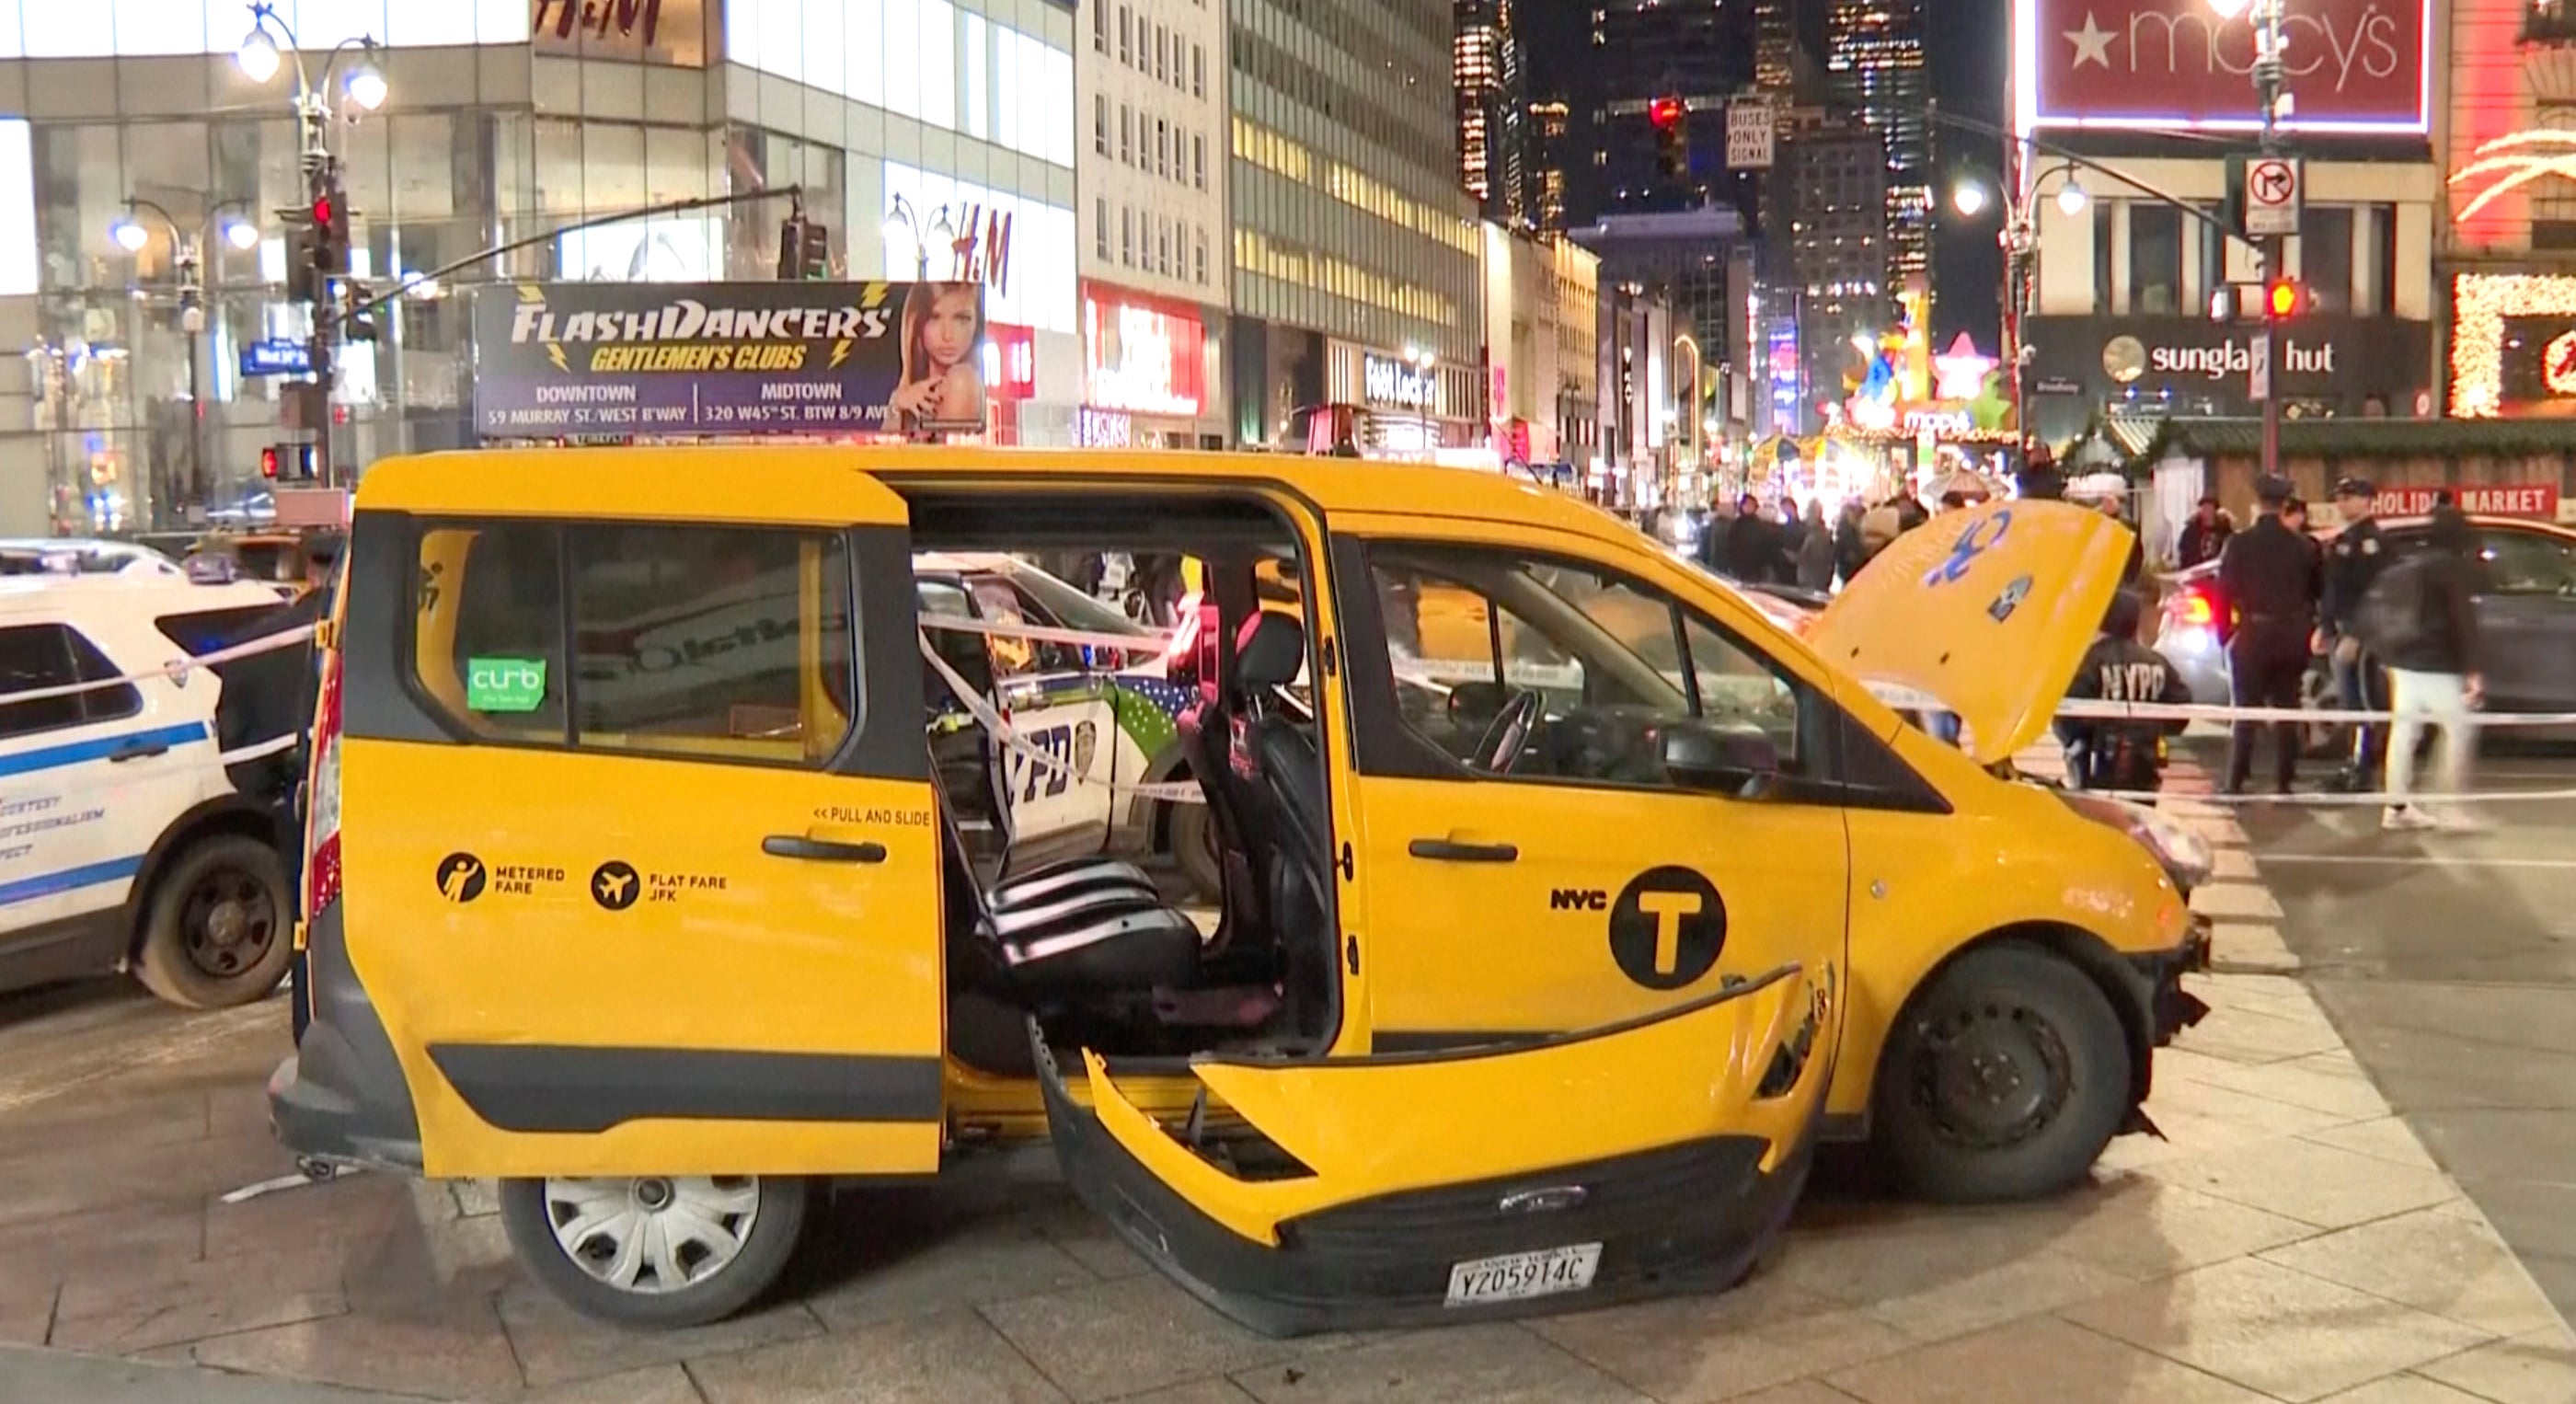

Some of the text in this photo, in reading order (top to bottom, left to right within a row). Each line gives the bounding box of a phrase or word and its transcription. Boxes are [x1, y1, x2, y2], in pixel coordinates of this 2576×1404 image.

[1731, 111, 1770, 127] BUSES
[1733, 130, 1766, 144] ONLY
[1731, 148, 1768, 162] SIGNAL
[590, 344, 808, 373] GENTLEMEN'S CLUBS
[2152, 339, 2334, 379] sungla hut
[536, 385, 637, 403] DOWNTOWN
[761, 382, 843, 400] MIDTOWN
[489, 409, 506, 425] 59
[510, 409, 570, 424] MURRAY
[641, 406, 686, 421] B'WAY
[705, 405, 733, 420] 320
[804, 405, 836, 420] BTW
[838, 405, 863, 420] 8/9
[2367, 489, 2546, 516] HOLID MARKET
[472, 668, 540, 689] curb
[2099, 662, 2166, 702] NYPD
[831, 807, 862, 823] PULL
[865, 809, 892, 824] AND
[895, 810, 930, 827] SLIDE
[496, 866, 565, 881] METERED
[650, 873, 727, 890] FLAT FARE
[495, 880, 532, 894] FARE
[649, 889, 676, 903] JFK
[1550, 889, 1702, 975] NYC T
